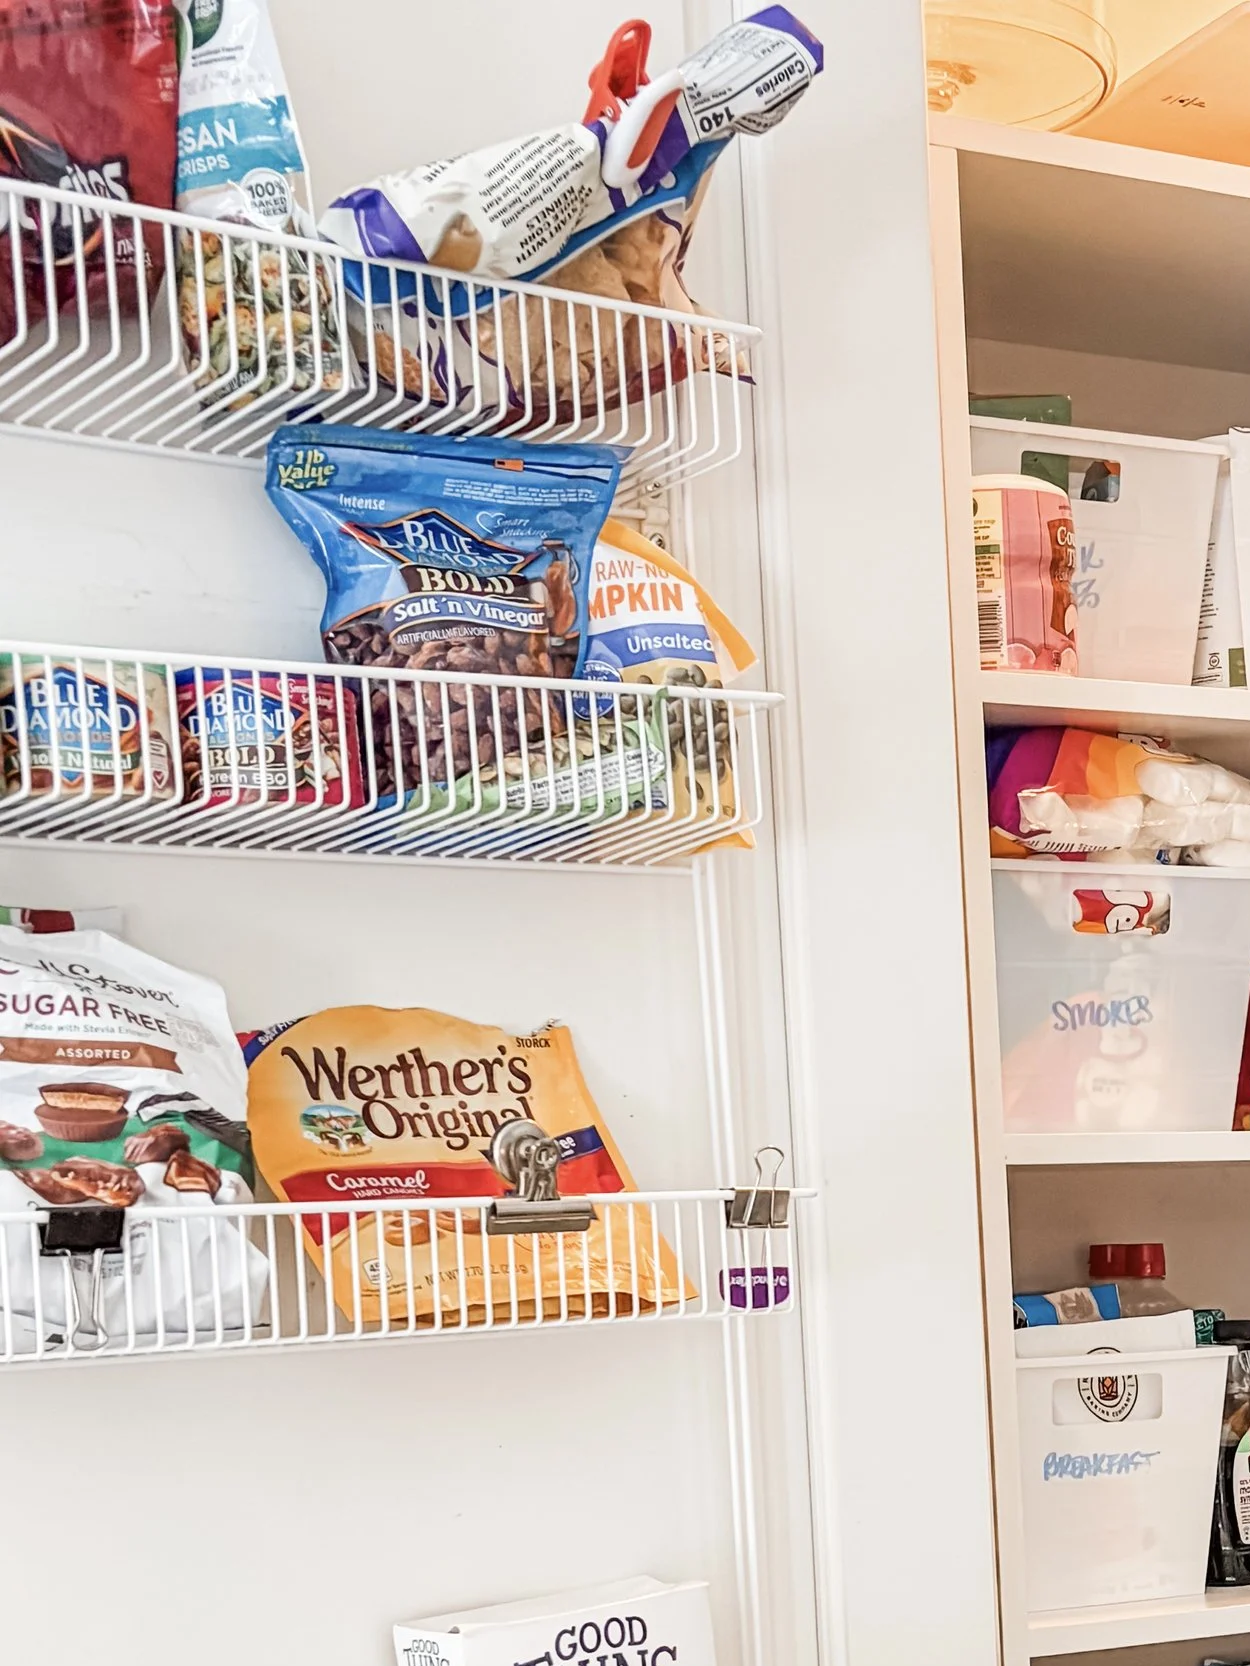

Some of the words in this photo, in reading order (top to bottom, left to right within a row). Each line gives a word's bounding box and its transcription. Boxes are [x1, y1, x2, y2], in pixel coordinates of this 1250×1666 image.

[755, 59, 806, 100] Calories
[699, 106, 736, 134] 140
[539, 144, 585, 186] high-quality
[249, 179, 287, 199] 100%
[501, 193, 542, 229] harvesting
[526, 185, 575, 232] KERNELS
[519, 222, 549, 250] CORN
[516, 236, 547, 265] WITH
[278, 462, 335, 483] Value
[339, 495, 386, 512] Intense
[496, 514, 530, 530] Smart
[402, 520, 476, 557] BLUE
[419, 568, 516, 596] BOLD
[470, 601, 545, 629] Vinegar
[451, 626, 496, 640] FLAVORED
[31, 679, 103, 709] BLUE
[0, 703, 137, 733] DAMOND
[208, 745, 275, 768] BOLD
[25, 1022, 54, 1033] Made
[57, 1023, 80, 1034] with
[83, 1023, 116, 1035] Stevia
[109, 1003, 171, 1037] FREE
[55, 1046, 131, 1061] ASSORTED
[516, 1036, 552, 1049] STORCK
[281, 1043, 531, 1103] Werther's
[325, 1170, 431, 1194] Caramel
[352, 1187, 381, 1199] HARD
[411, 1639, 440, 1656] GOOD
[555, 1616, 647, 1661] GOOD
